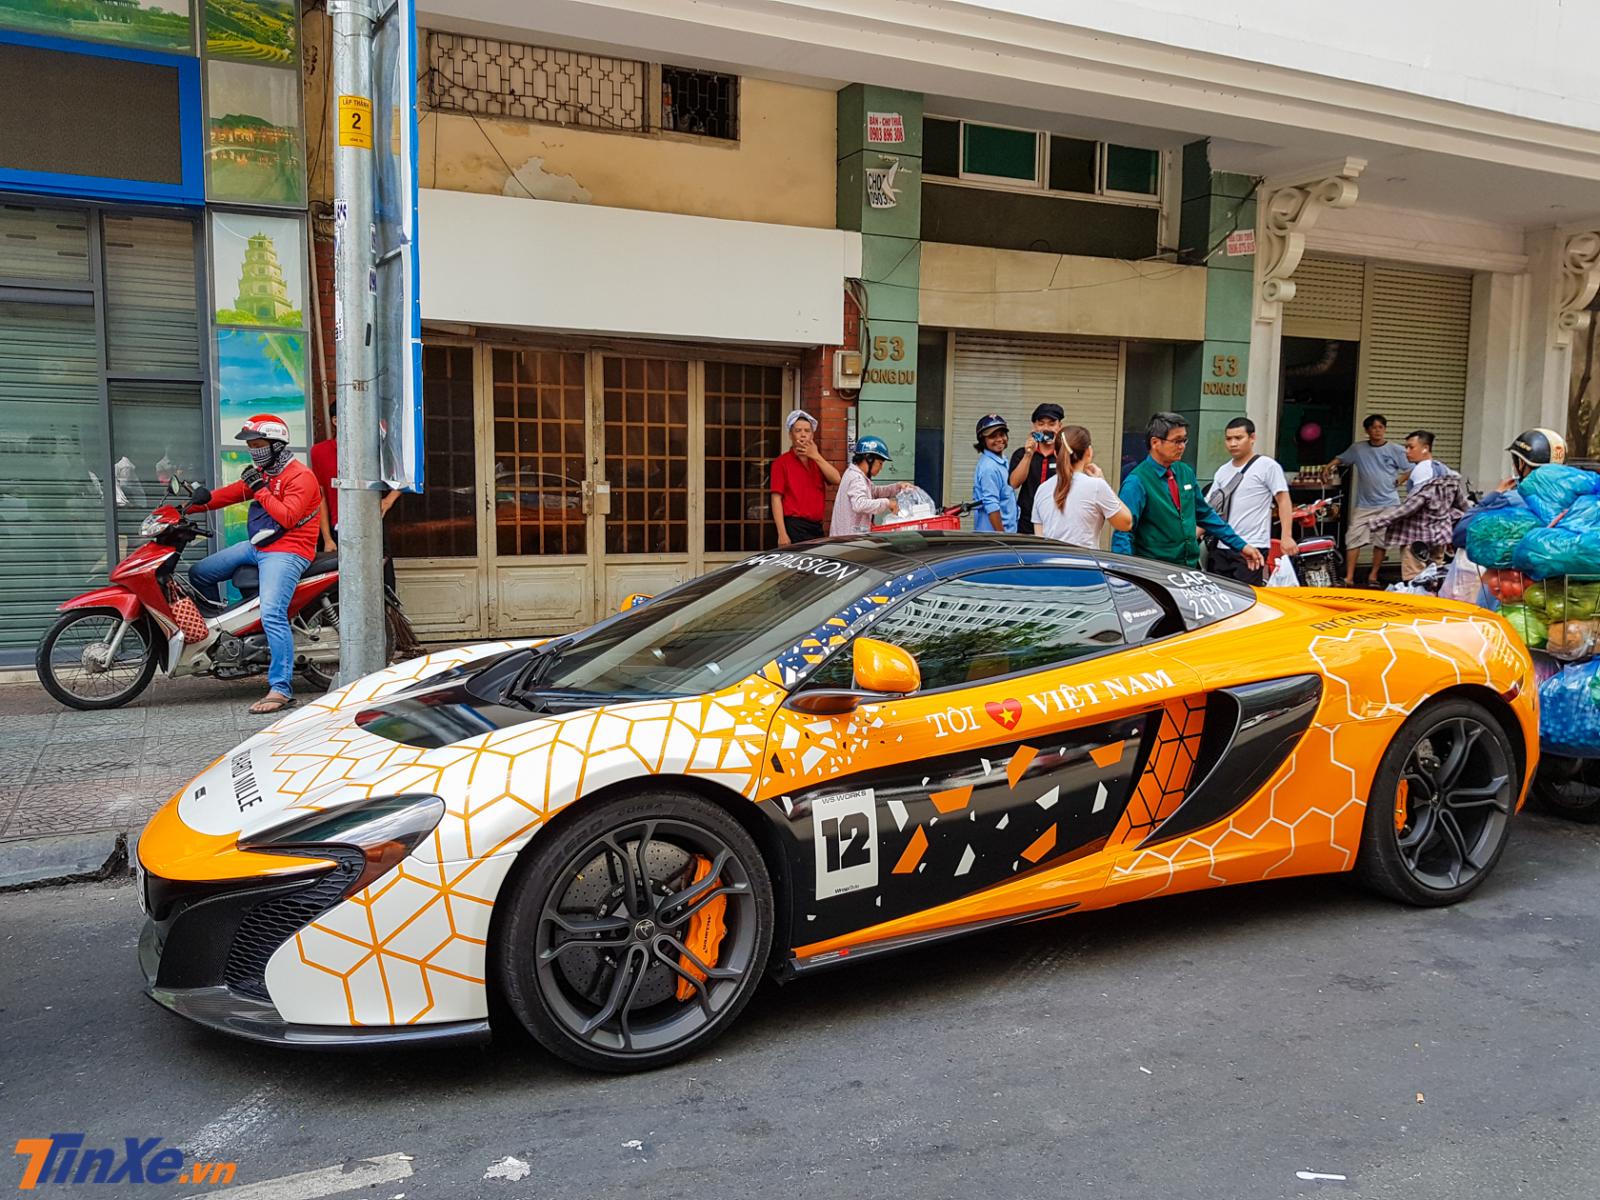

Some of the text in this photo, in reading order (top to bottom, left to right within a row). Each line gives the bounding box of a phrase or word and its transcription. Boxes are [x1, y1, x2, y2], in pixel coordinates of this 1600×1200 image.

[352, 112, 362, 130] 2
[873, 335, 905, 361] 53
[1212, 355, 1239, 377] 53
[769, 554, 860, 581] PASSION
[1167, 571, 1213, 588] CAR
[1189, 592, 1234, 620] 2019
[1027, 682, 1101, 715] VIỆT
[1102, 669, 1176, 700] NAM
[821, 811, 871, 873] 12
